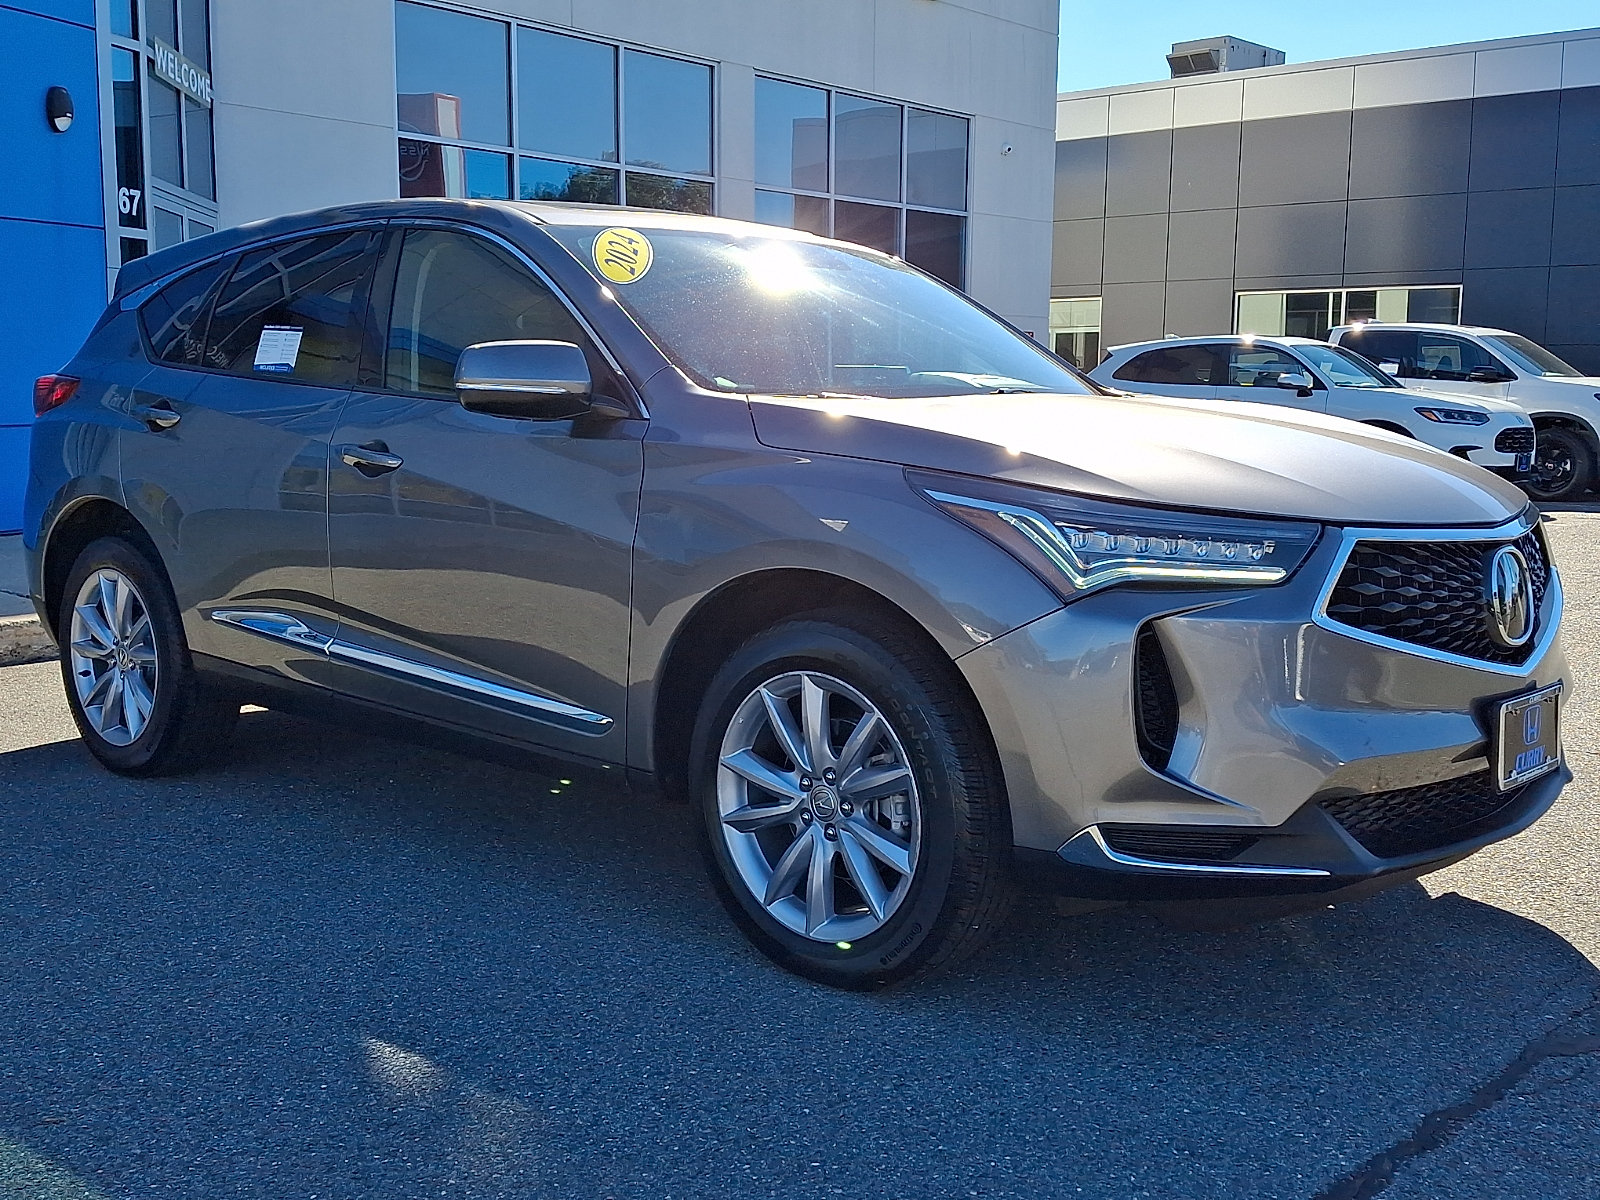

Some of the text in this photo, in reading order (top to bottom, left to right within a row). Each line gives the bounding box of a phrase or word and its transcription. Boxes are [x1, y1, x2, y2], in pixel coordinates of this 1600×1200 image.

[154, 44, 211, 101] WELCOME
[118, 187, 141, 216] 67
[604, 231, 640, 276] 2024
[1516, 745, 1545, 771] CURRY
